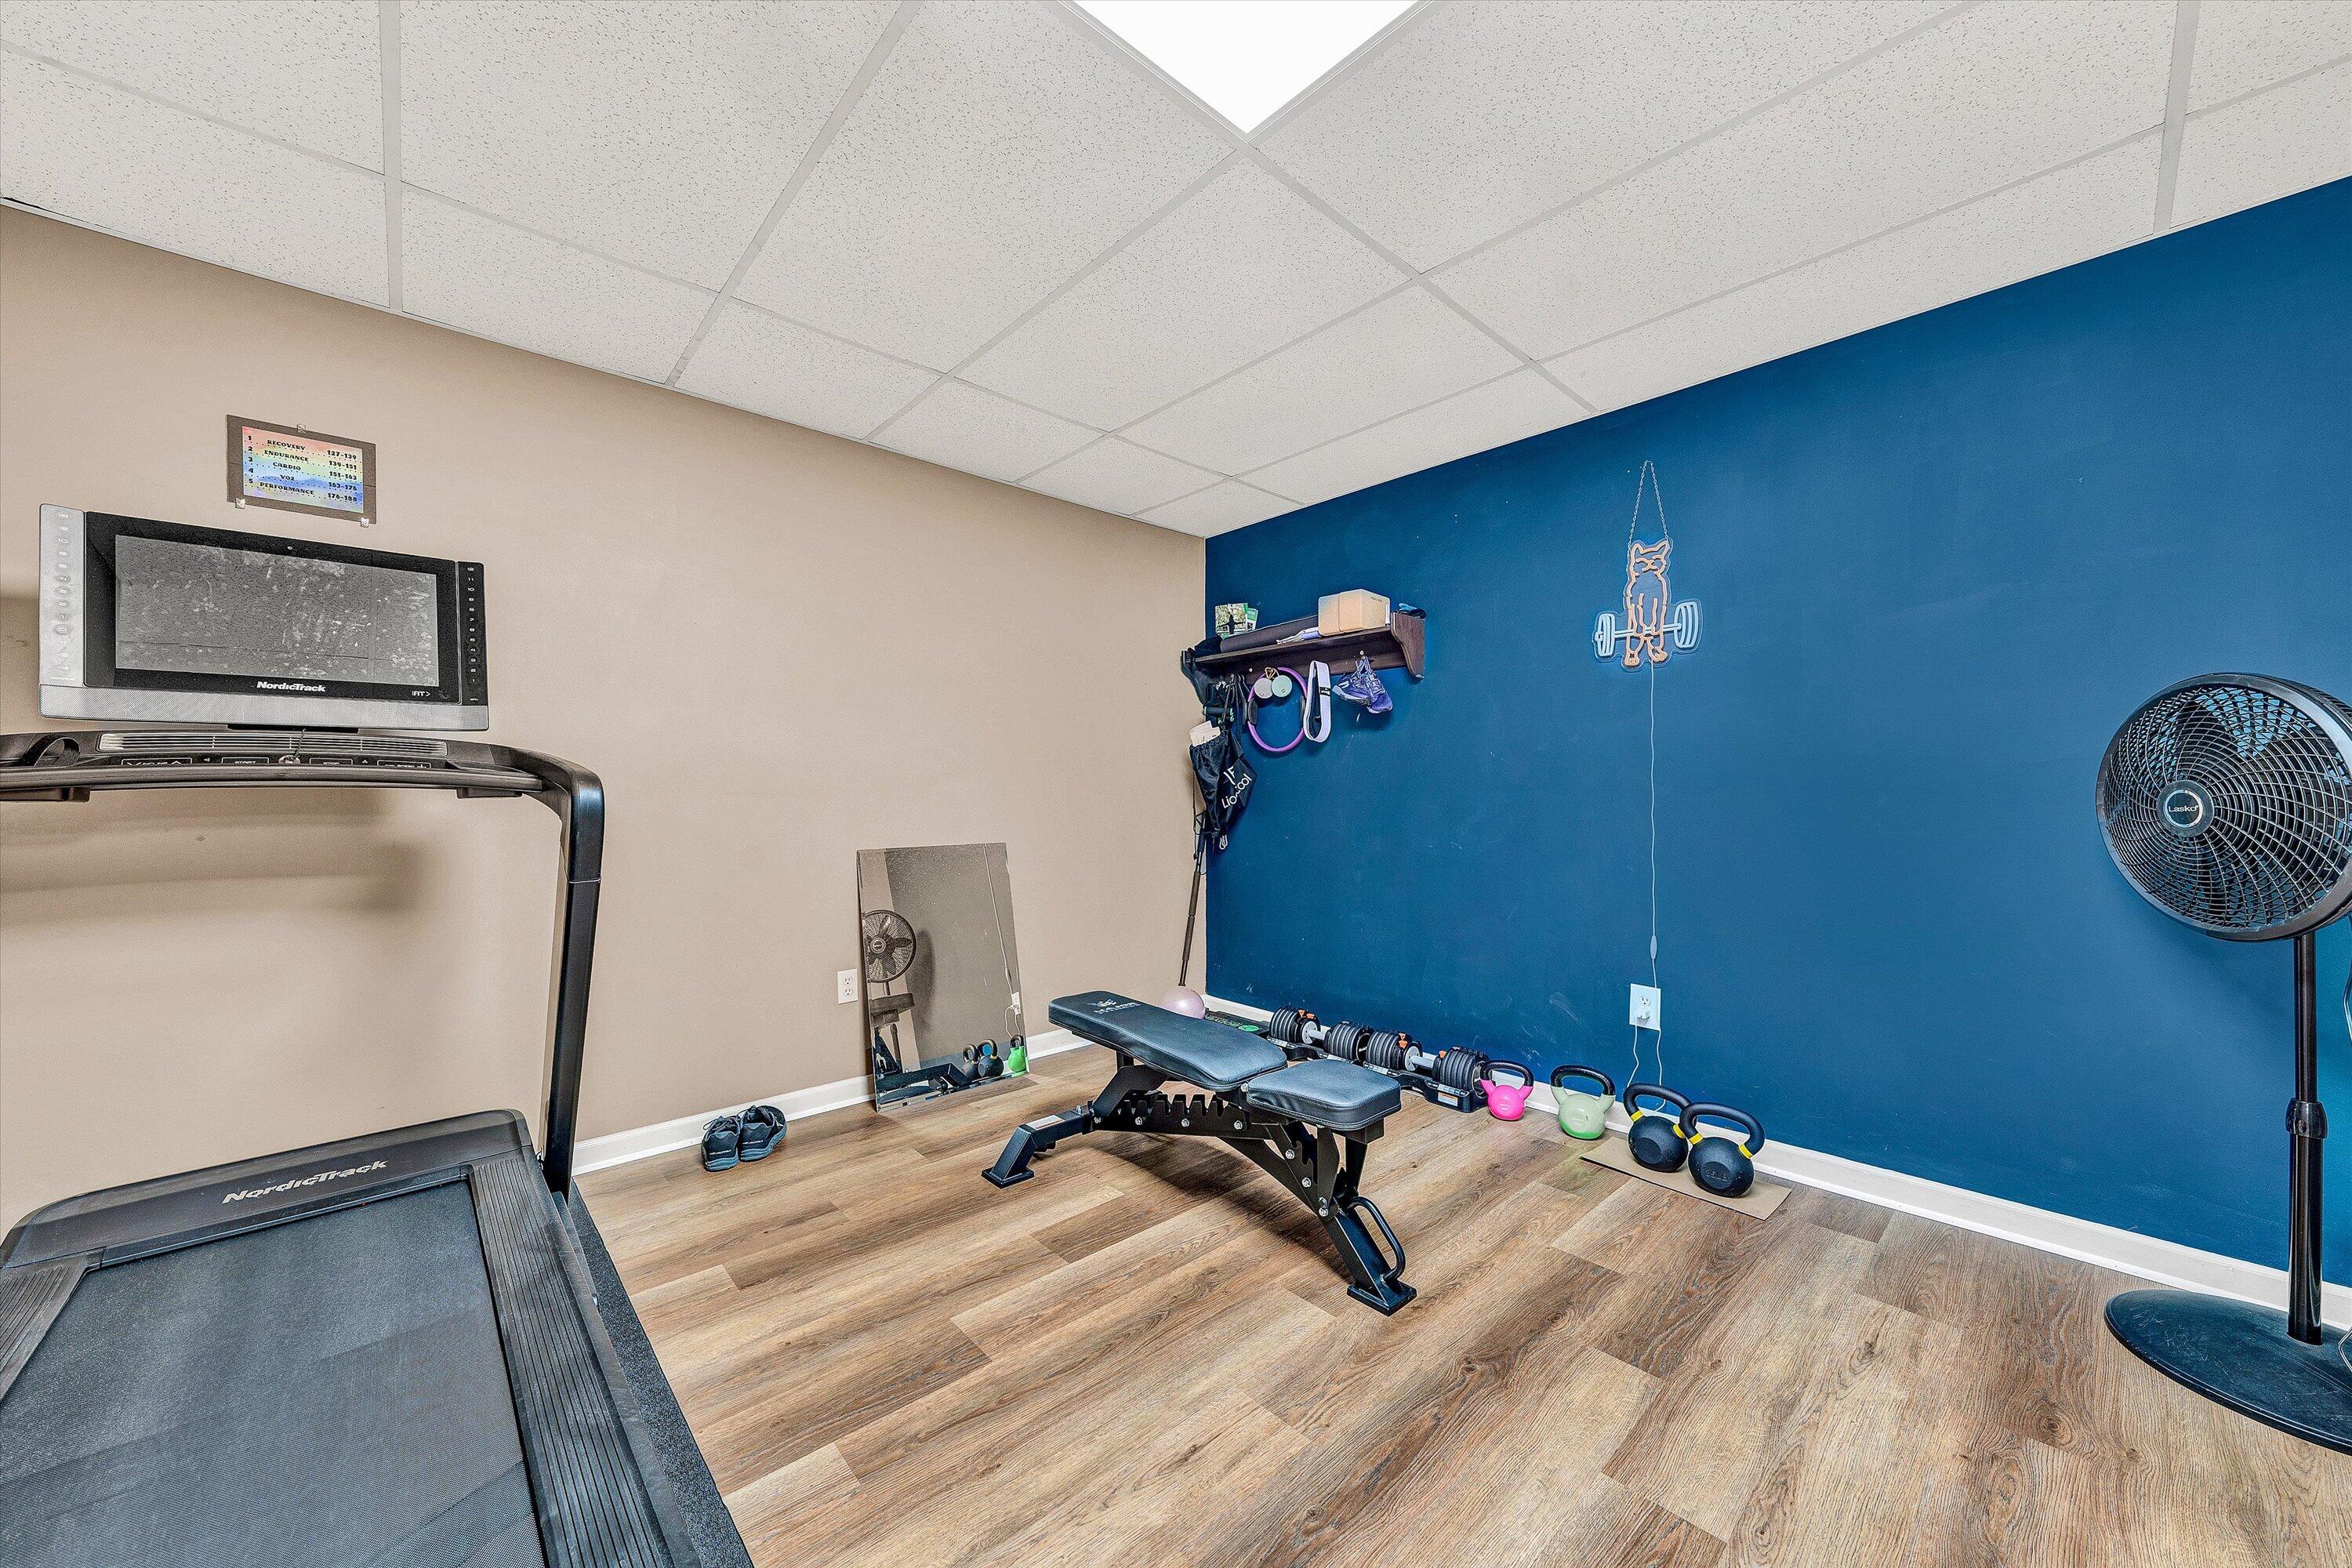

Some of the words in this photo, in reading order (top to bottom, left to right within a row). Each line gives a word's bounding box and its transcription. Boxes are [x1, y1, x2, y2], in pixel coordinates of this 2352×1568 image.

[264, 449, 309, 462] ENDURANCE
[328, 460, 357, 470] 139-151
[267, 439, 306, 451] RECOVERY
[327, 450, 357, 460] 127-139
[273, 462, 301, 470] CARDIO
[329, 471, 358, 480] 151-163
[260, 482, 314, 495] PERFORMANCE
[328, 492, 358, 502] 176-188
[328, 481, 358, 491] 163-176
[256, 681, 327, 692] NordicTrack
[221, 1160, 389, 1204] NordicTrack
